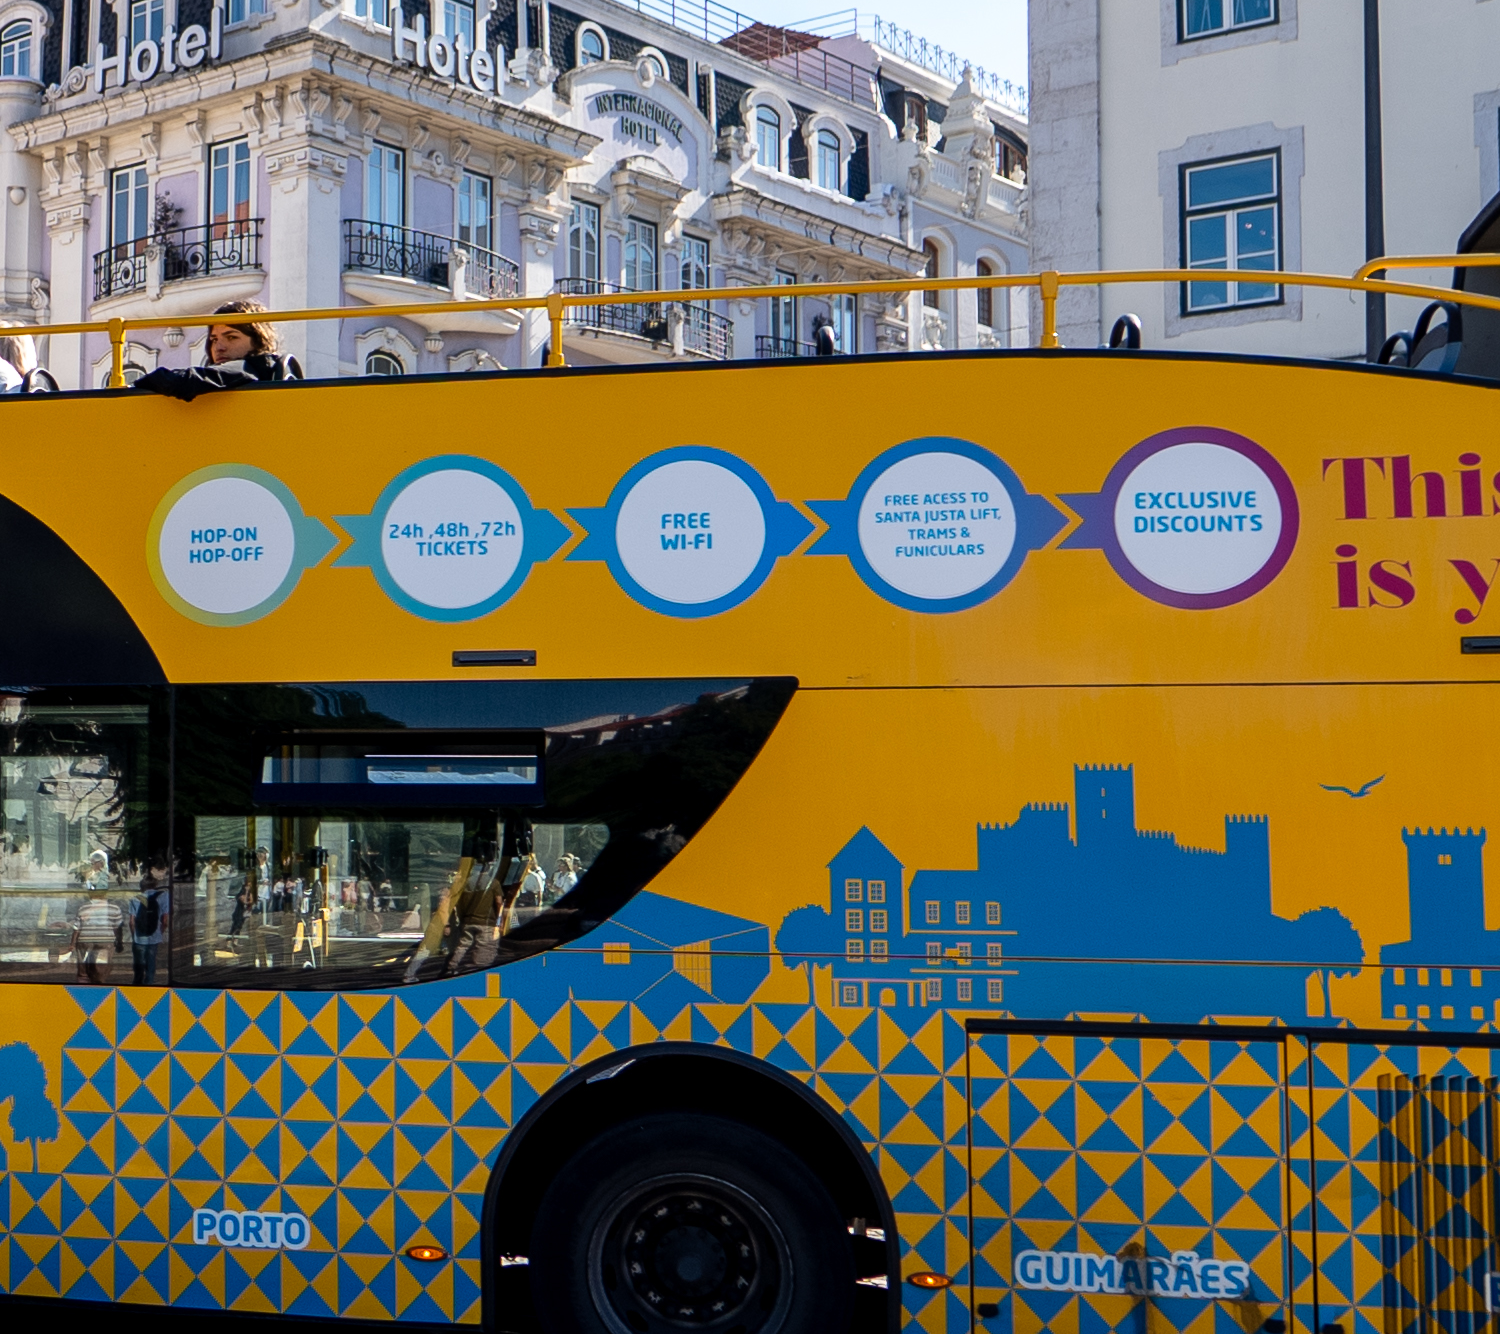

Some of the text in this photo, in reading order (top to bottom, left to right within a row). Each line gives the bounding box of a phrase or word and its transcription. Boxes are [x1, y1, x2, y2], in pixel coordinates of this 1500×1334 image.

[95, 6, 223, 93] Hotel
[392, 7, 504, 95] Hotel
[595, 93, 683, 144] INTERNACIONAL
[621, 115, 661, 146] HOTEL
[884, 491, 989, 506] FREE ACESS TO
[1134, 490, 1257, 511] EXCLUSIVE
[661, 512, 711, 531] FREE
[875, 511, 921, 523] SANTA
[924, 509, 966, 524] JUSTA
[1133, 513, 1263, 534] DISCOUNTS
[190, 527, 258, 544] HOP-ON
[389, 522, 423, 539] 24h
[908, 527, 971, 540] TRAMS &
[416, 540, 489, 558] TICKETS
[660, 533, 713, 552] WI-FI
[895, 544, 985, 557] FUNICULARS
[189, 546, 264, 564] HOP-OFF
[1330, 544, 1416, 609] is
[195, 1211, 308, 1246] PORTO
[1017, 1250, 1249, 1299] GUIMARÃES
